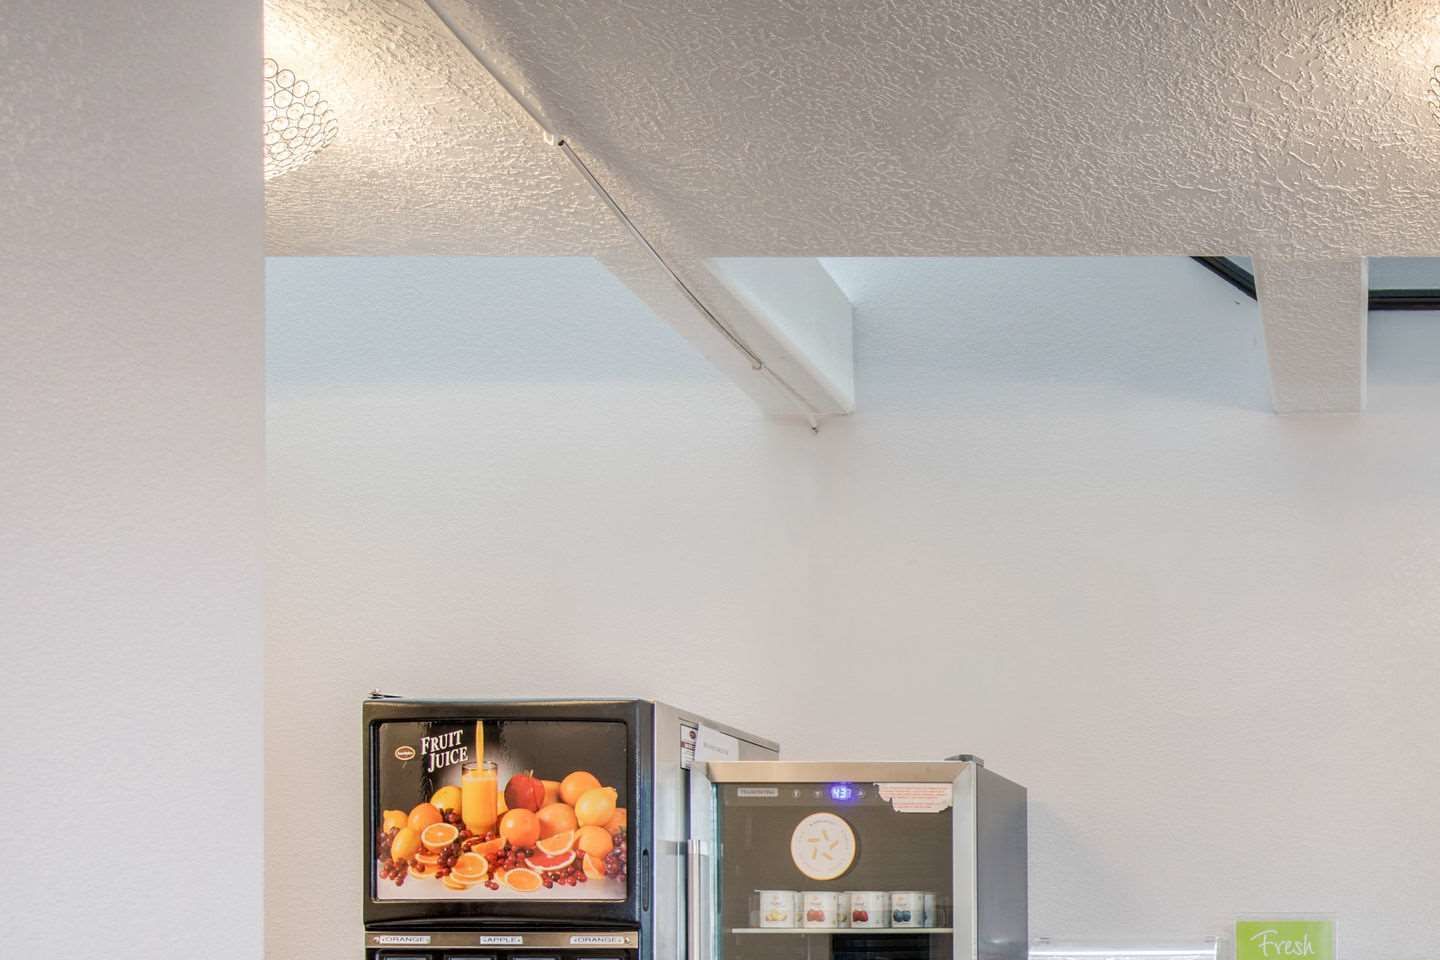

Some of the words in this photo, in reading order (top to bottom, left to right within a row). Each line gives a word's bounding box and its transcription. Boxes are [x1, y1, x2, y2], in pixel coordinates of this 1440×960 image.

[421, 729, 464, 755] FRUIT
[428, 746, 469, 773] JUICE
[384, 935, 427, 944] ORANGE
[487, 935, 518, 944] APPLE
[576, 935, 618, 944] ORANGE
[1249, 929, 1316, 957] Fresh
